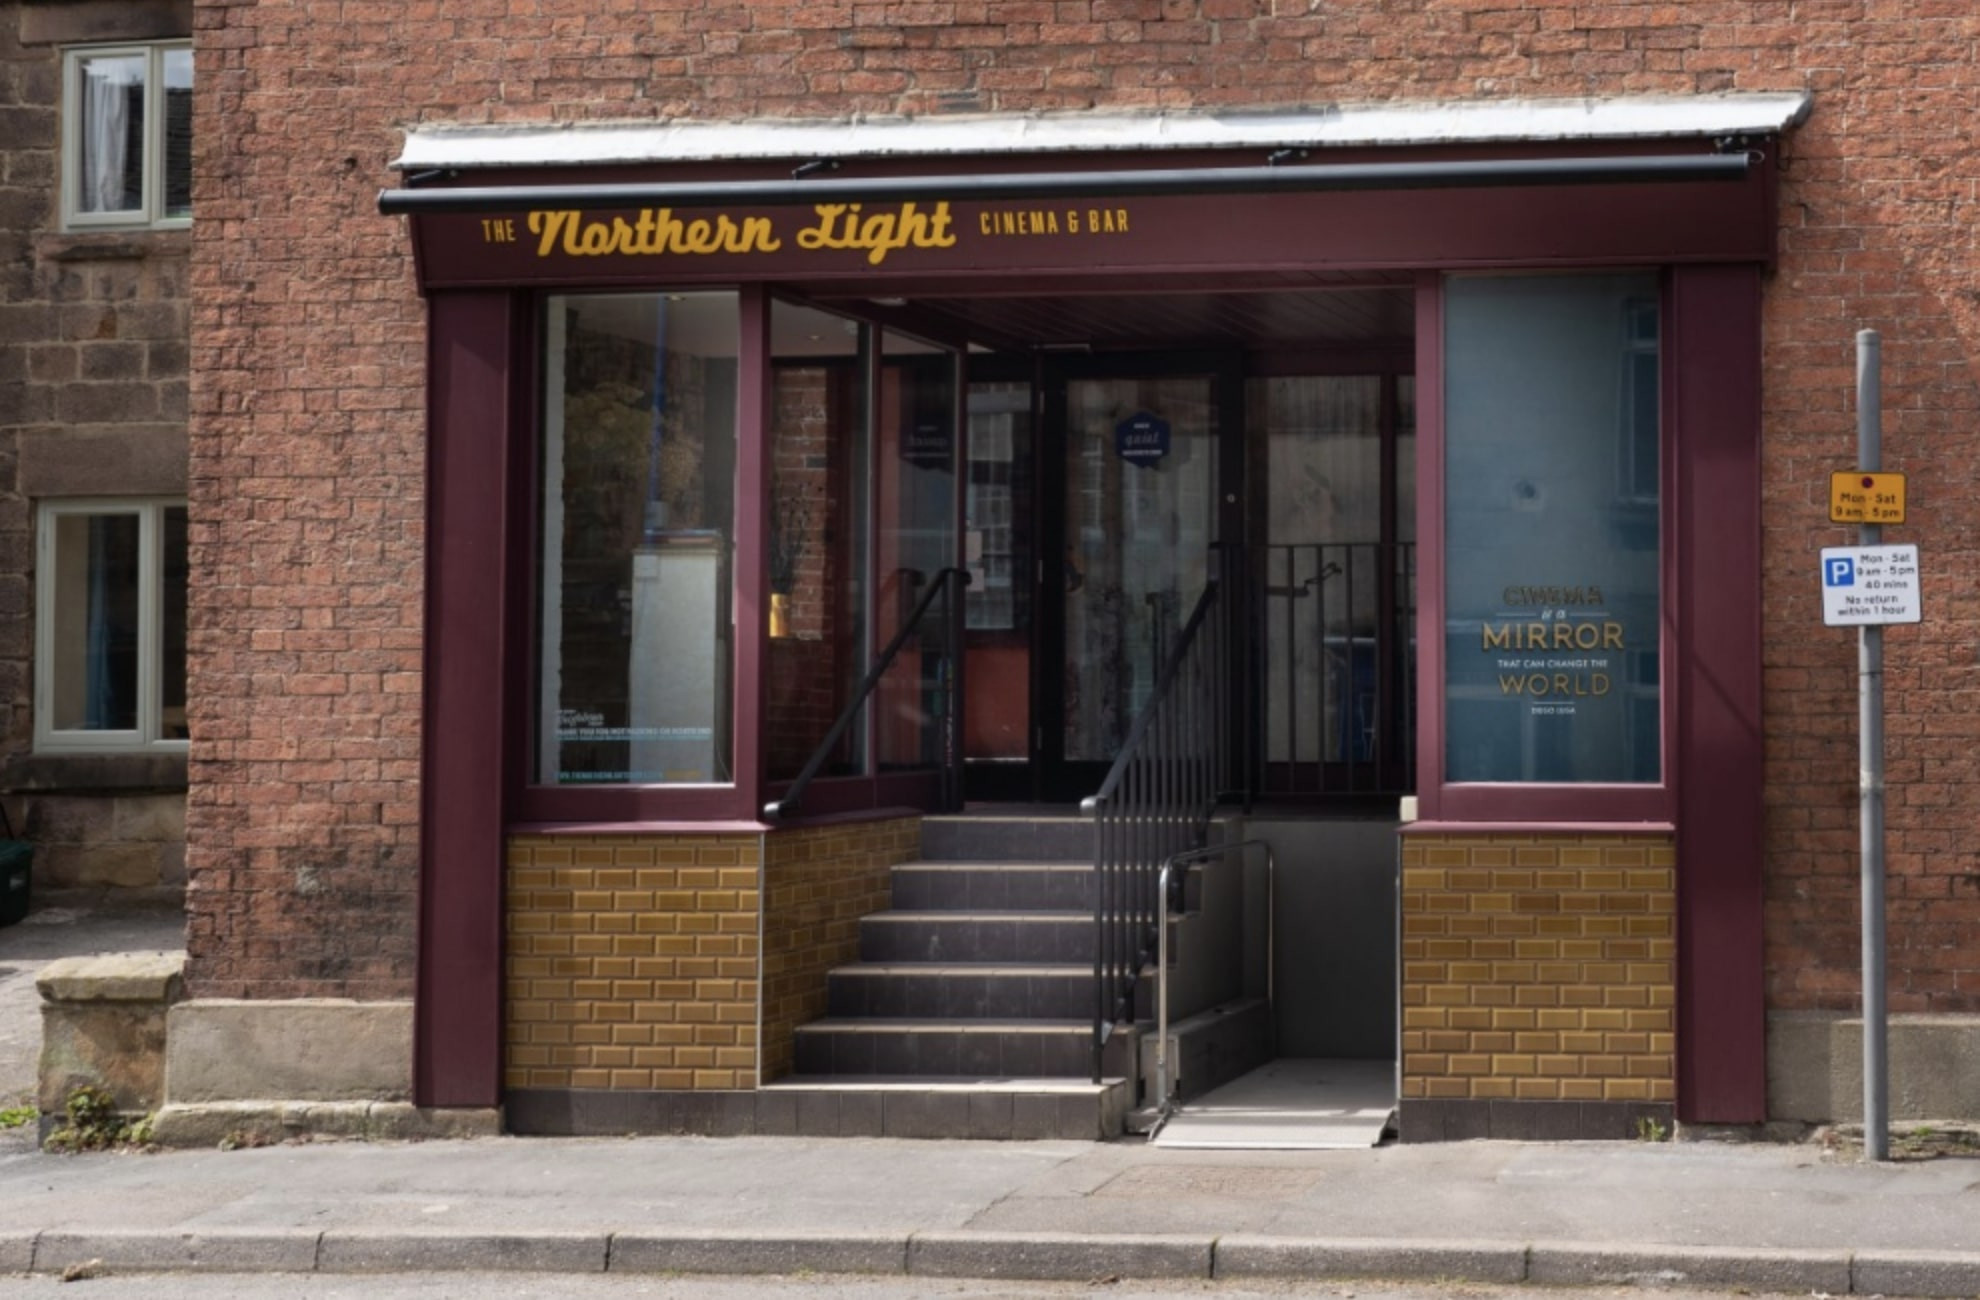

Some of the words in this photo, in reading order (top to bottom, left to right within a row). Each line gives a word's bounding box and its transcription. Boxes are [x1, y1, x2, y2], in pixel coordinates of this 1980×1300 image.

[482, 220, 516, 242] THE
[527, 208, 781, 257] Northern
[796, 202, 957, 265] Light
[980, 211, 1059, 235] CINEMA
[1067, 210, 1079, 233] &
[1088, 209, 1129, 233] BAR
[1841, 492, 1866, 503] Mon
[1875, 493, 1896, 504] Sat
[1860, 554, 1883, 564] Mon
[1891, 553, 1911, 563] Sat
[1831, 561, 1850, 585] P
[1865, 580, 1881, 589] 40
[1883, 580, 1908, 589] mins
[1503, 586, 1604, 606] CINEMA
[1846, 596, 1861, 605] No
[1864, 595, 1898, 605] return
[1541, 606, 1552, 620] is
[1555, 609, 1566, 619] a
[1838, 606, 1871, 616] within
[1881, 606, 1906, 615] hour
[1482, 621, 1625, 651] MIRROR
[1498, 659, 1521, 669] THAT
[1523, 659, 1545, 669] CAN
[1547, 659, 1587, 669] CHANGE
[1591, 659, 1608, 669] THE
[1499, 673, 1610, 697] WORLD
